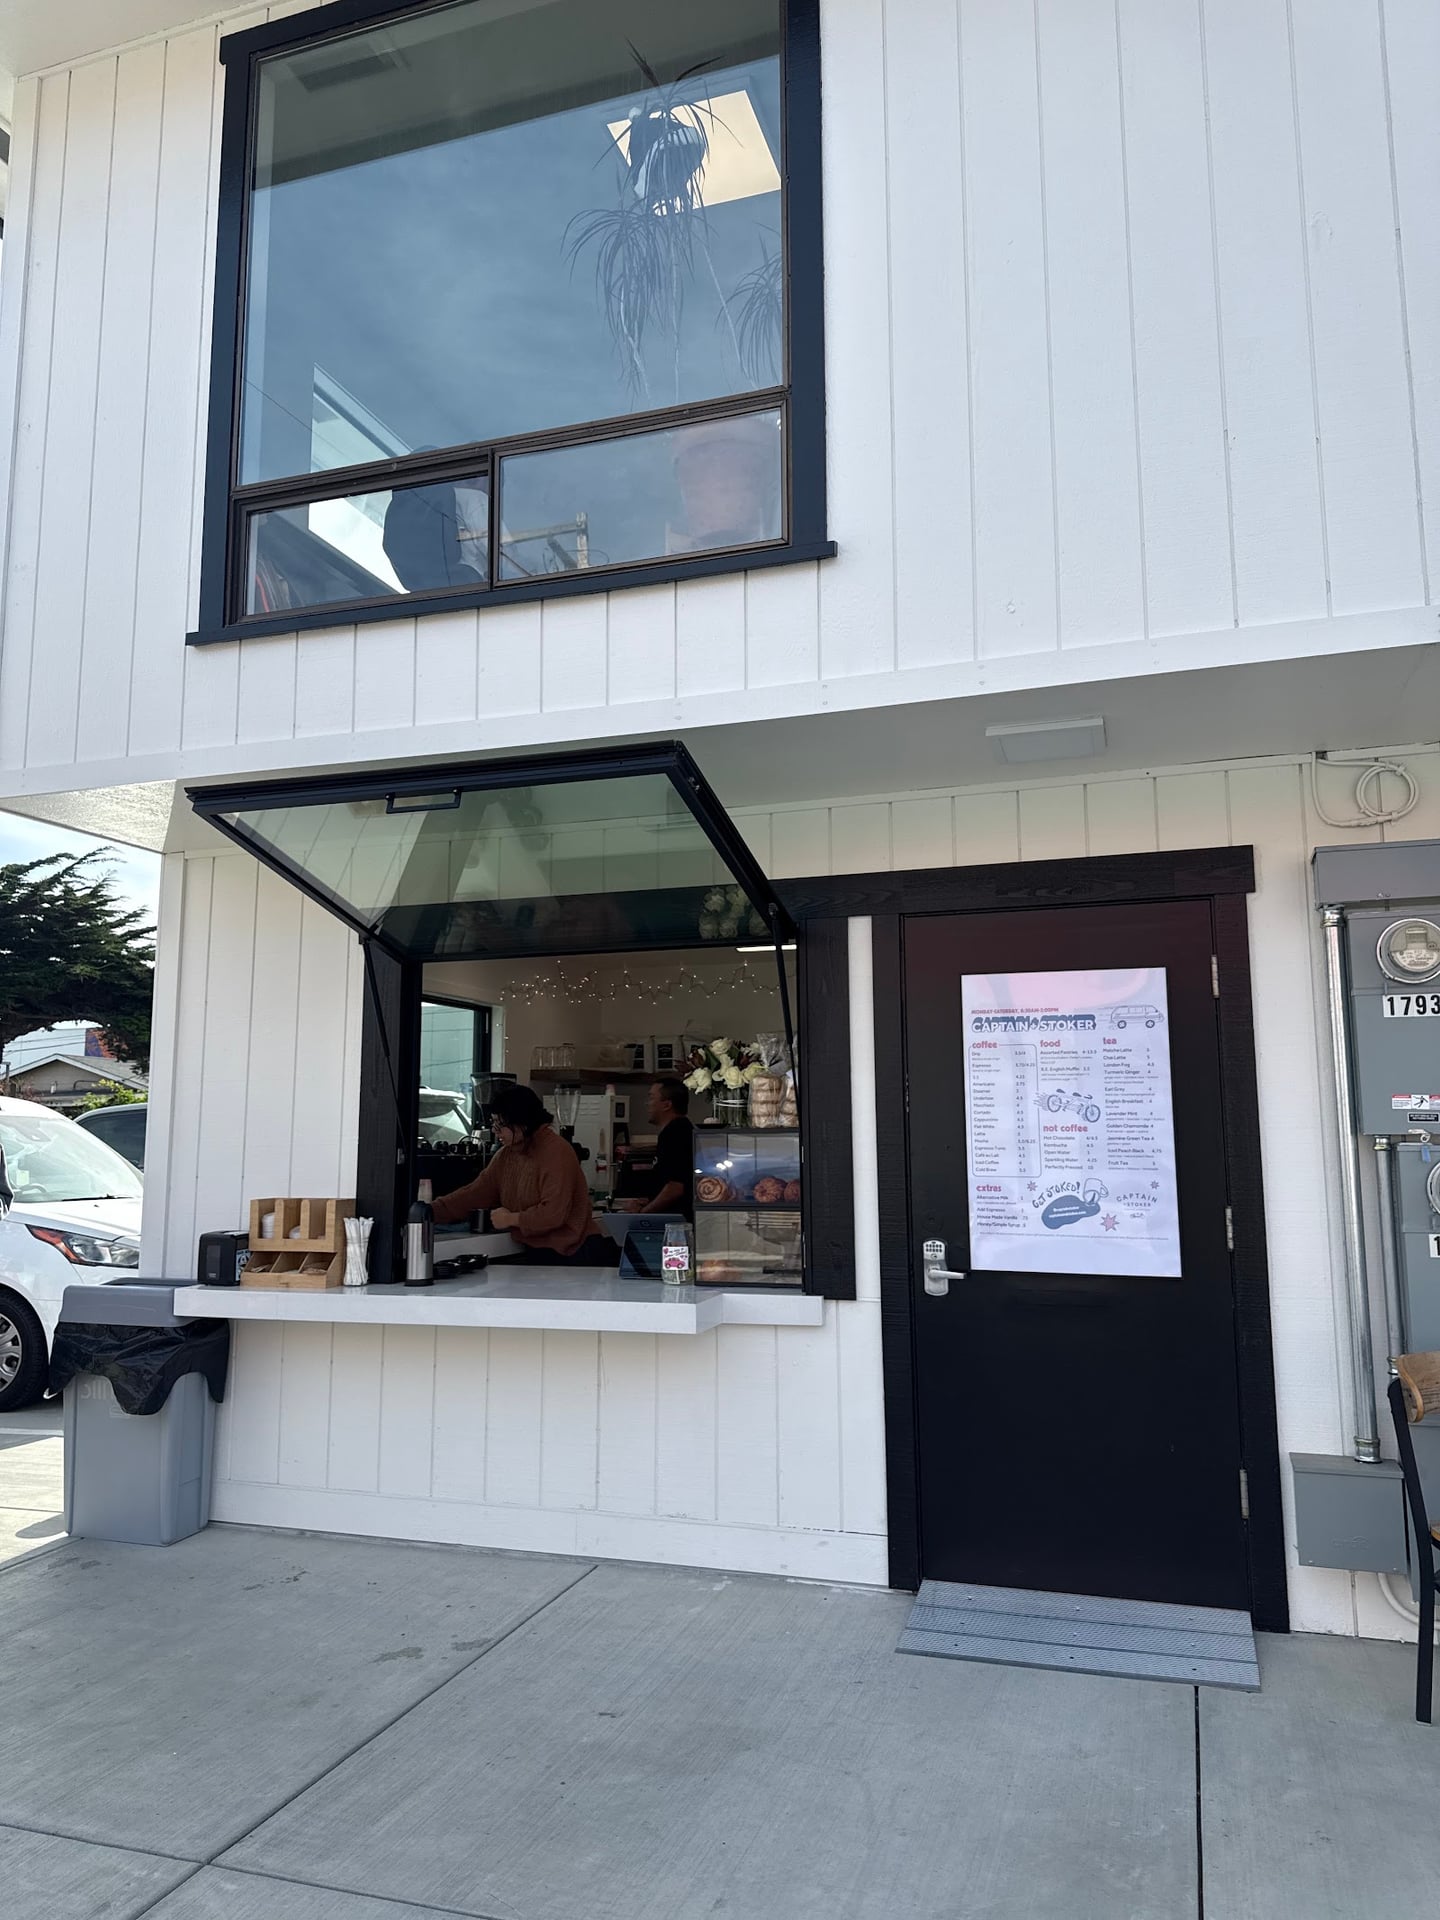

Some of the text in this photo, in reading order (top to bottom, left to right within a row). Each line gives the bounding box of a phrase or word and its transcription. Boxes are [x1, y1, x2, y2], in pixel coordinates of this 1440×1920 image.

[1387, 994, 1440, 1016] 1793
[972, 1016, 1030, 1033] CAPTAIN
[1039, 1015, 1096, 1031] STOKER
[972, 1040, 998, 1049] coffee
[1040, 1039, 1060, 1047] food
[1103, 1037, 1117, 1045] tea
[1060, 1124, 1088, 1132] coffee
[976, 1184, 1002, 1192] extras
[1032, 1181, 1080, 1208] GET STOKED!
[1116, 1193, 1158, 1203] CAPTAIN
